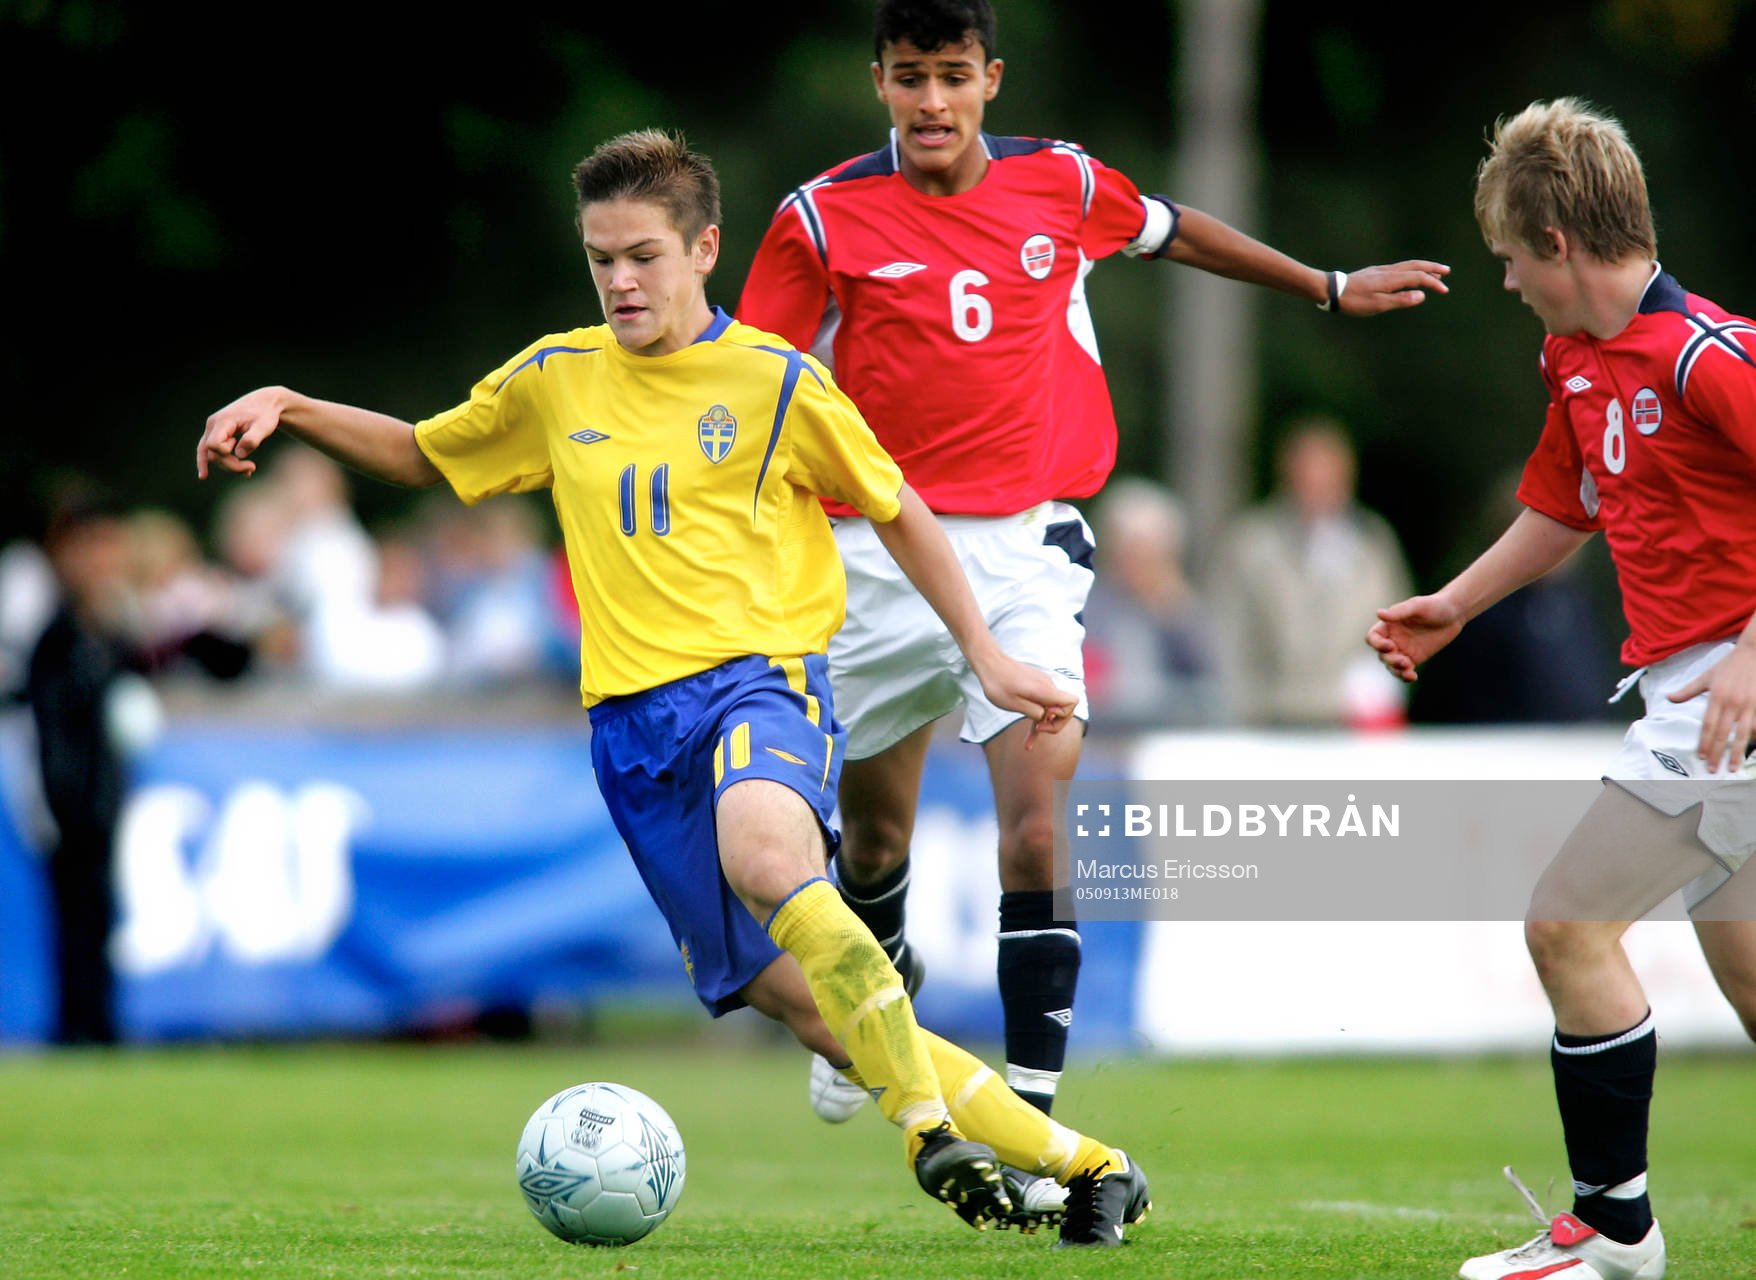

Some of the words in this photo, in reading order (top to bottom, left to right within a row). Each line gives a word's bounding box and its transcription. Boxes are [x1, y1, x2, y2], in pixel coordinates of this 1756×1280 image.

[949, 269, 993, 343] 6
[1603, 397, 1626, 475] 8
[618, 463, 671, 537] 11
